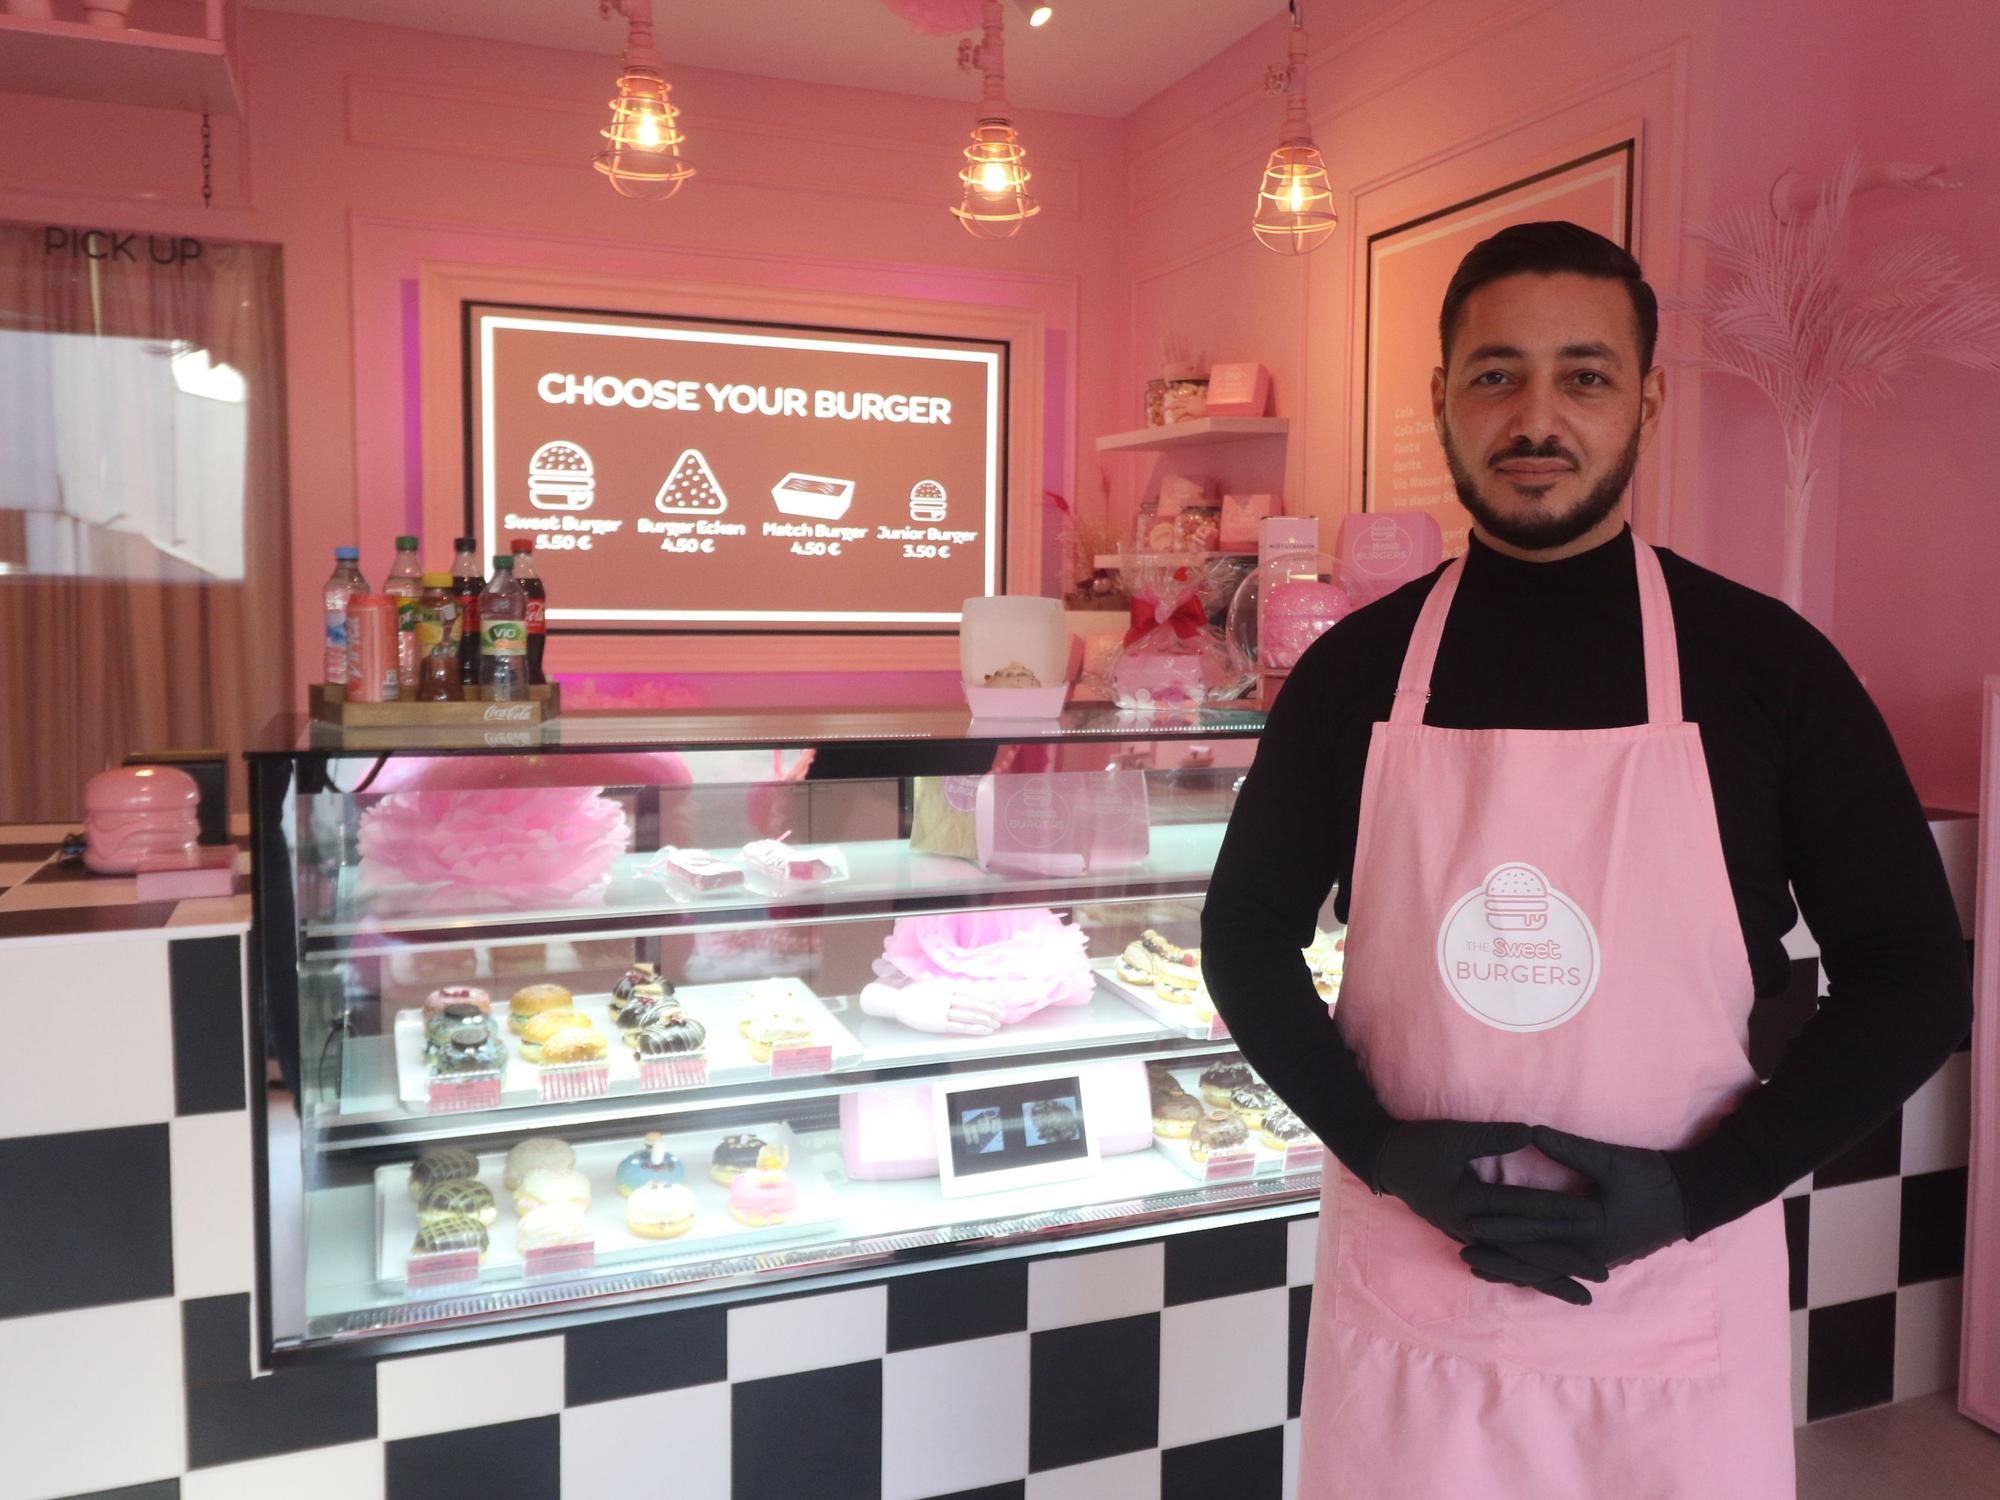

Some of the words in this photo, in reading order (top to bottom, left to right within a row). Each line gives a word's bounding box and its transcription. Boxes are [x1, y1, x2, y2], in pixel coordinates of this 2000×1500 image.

[44, 226, 137, 262] PICK
[149, 235, 203, 266] UP
[537, 372, 701, 411] CHOOSE
[704, 382, 808, 417] YOUR
[814, 389, 951, 425] BURGER
[504, 513, 561, 531] Sweet
[562, 516, 623, 535] Burger
[637, 518, 695, 537] Burger
[696, 520, 746, 536] Ecken
[814, 523, 868, 541] Burger
[535, 534, 576, 550] 5.50
[577, 535, 592, 550] €
[876, 525, 926, 541] Junior
[927, 527, 978, 544] Burger
[660, 538, 699, 553] 4.50
[700, 539, 715, 553] €
[790, 541, 827, 556] 4.50
[828, 542, 842, 556] €
[902, 544, 937, 558] 3.50
[938, 545, 951, 558] €
[1356, 550, 1408, 561] BURGERS
[1466, 940, 1491, 953] THE
[1493, 937, 1562, 960] Sweet
[1456, 961, 1581, 986] BURGERS
